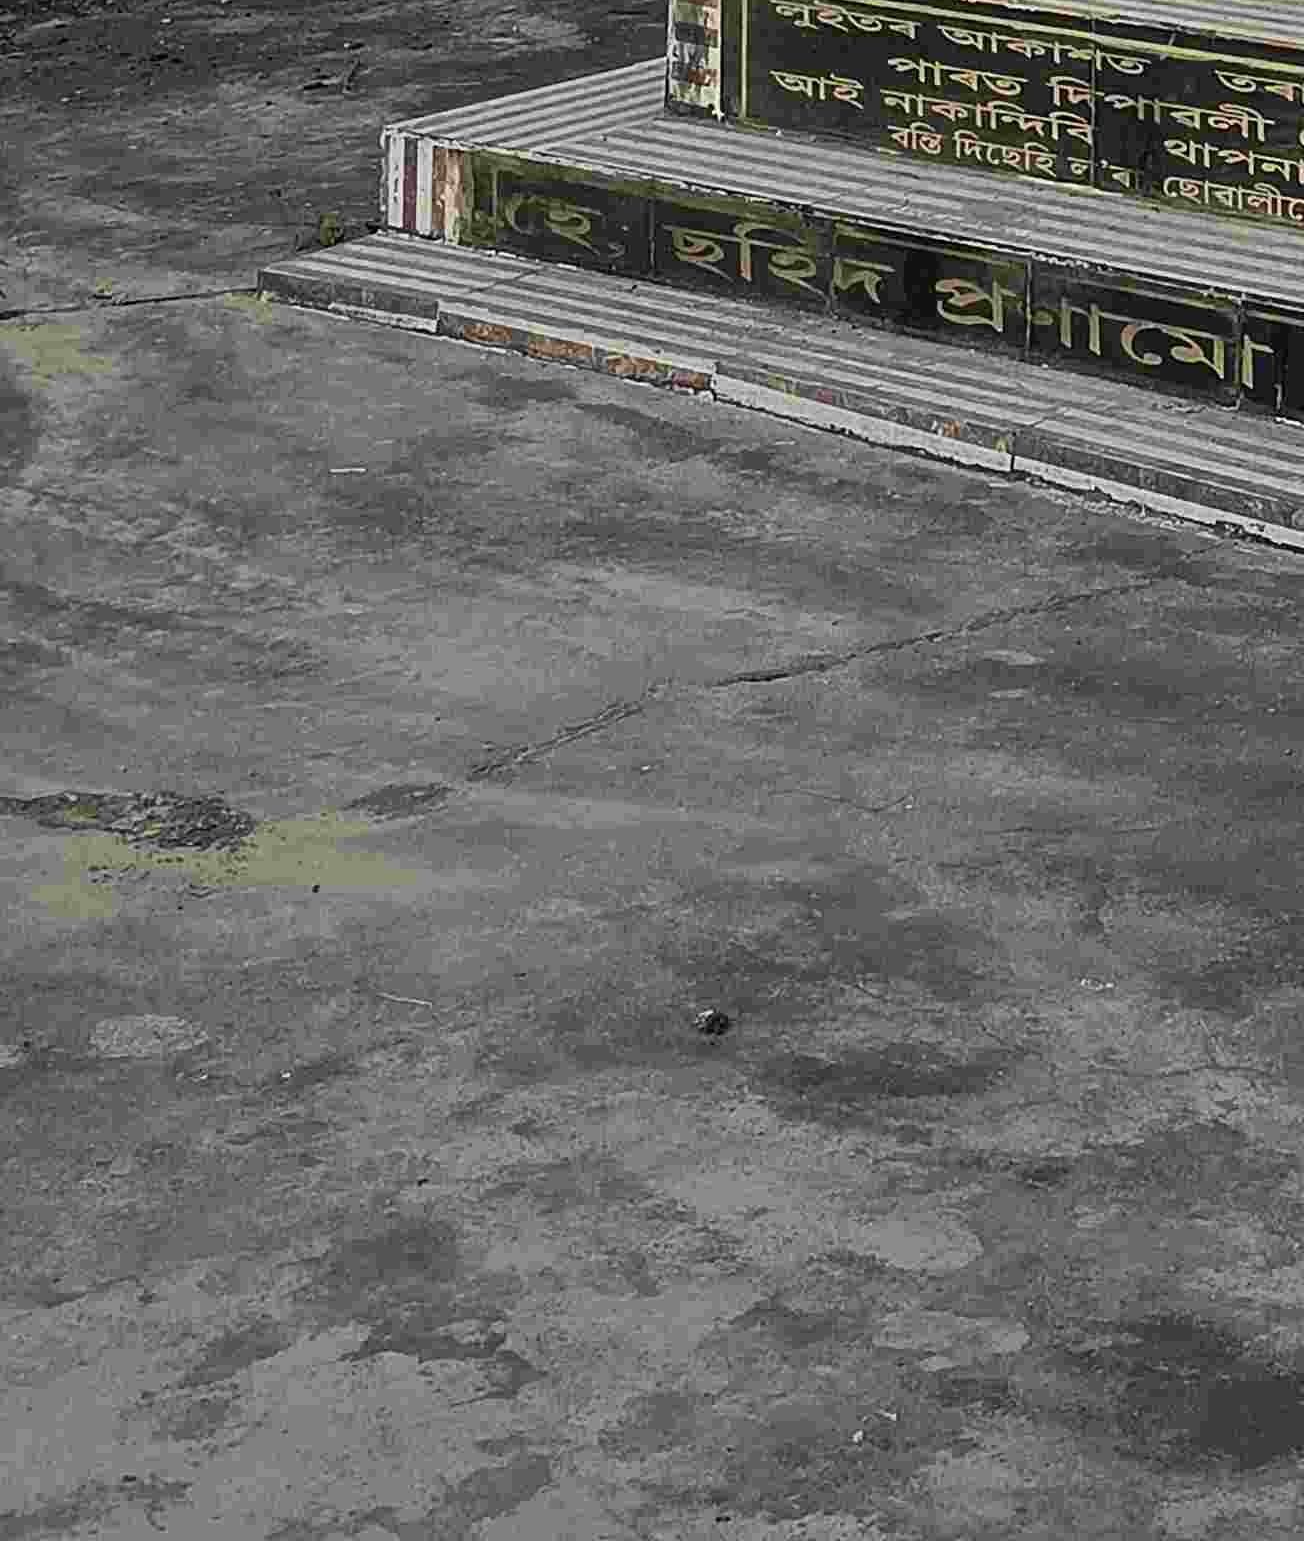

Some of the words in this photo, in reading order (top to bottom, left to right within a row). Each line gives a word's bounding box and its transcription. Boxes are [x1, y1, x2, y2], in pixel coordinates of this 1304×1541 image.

[937, 23, 1153, 75] আকাশত
[769, 70, 865, 109] আই
[888, 55, 1029, 97] পাৰত
[953, 129, 1058, 178] দিছেহি
[661, 219, 896, 308] ছহিদ
